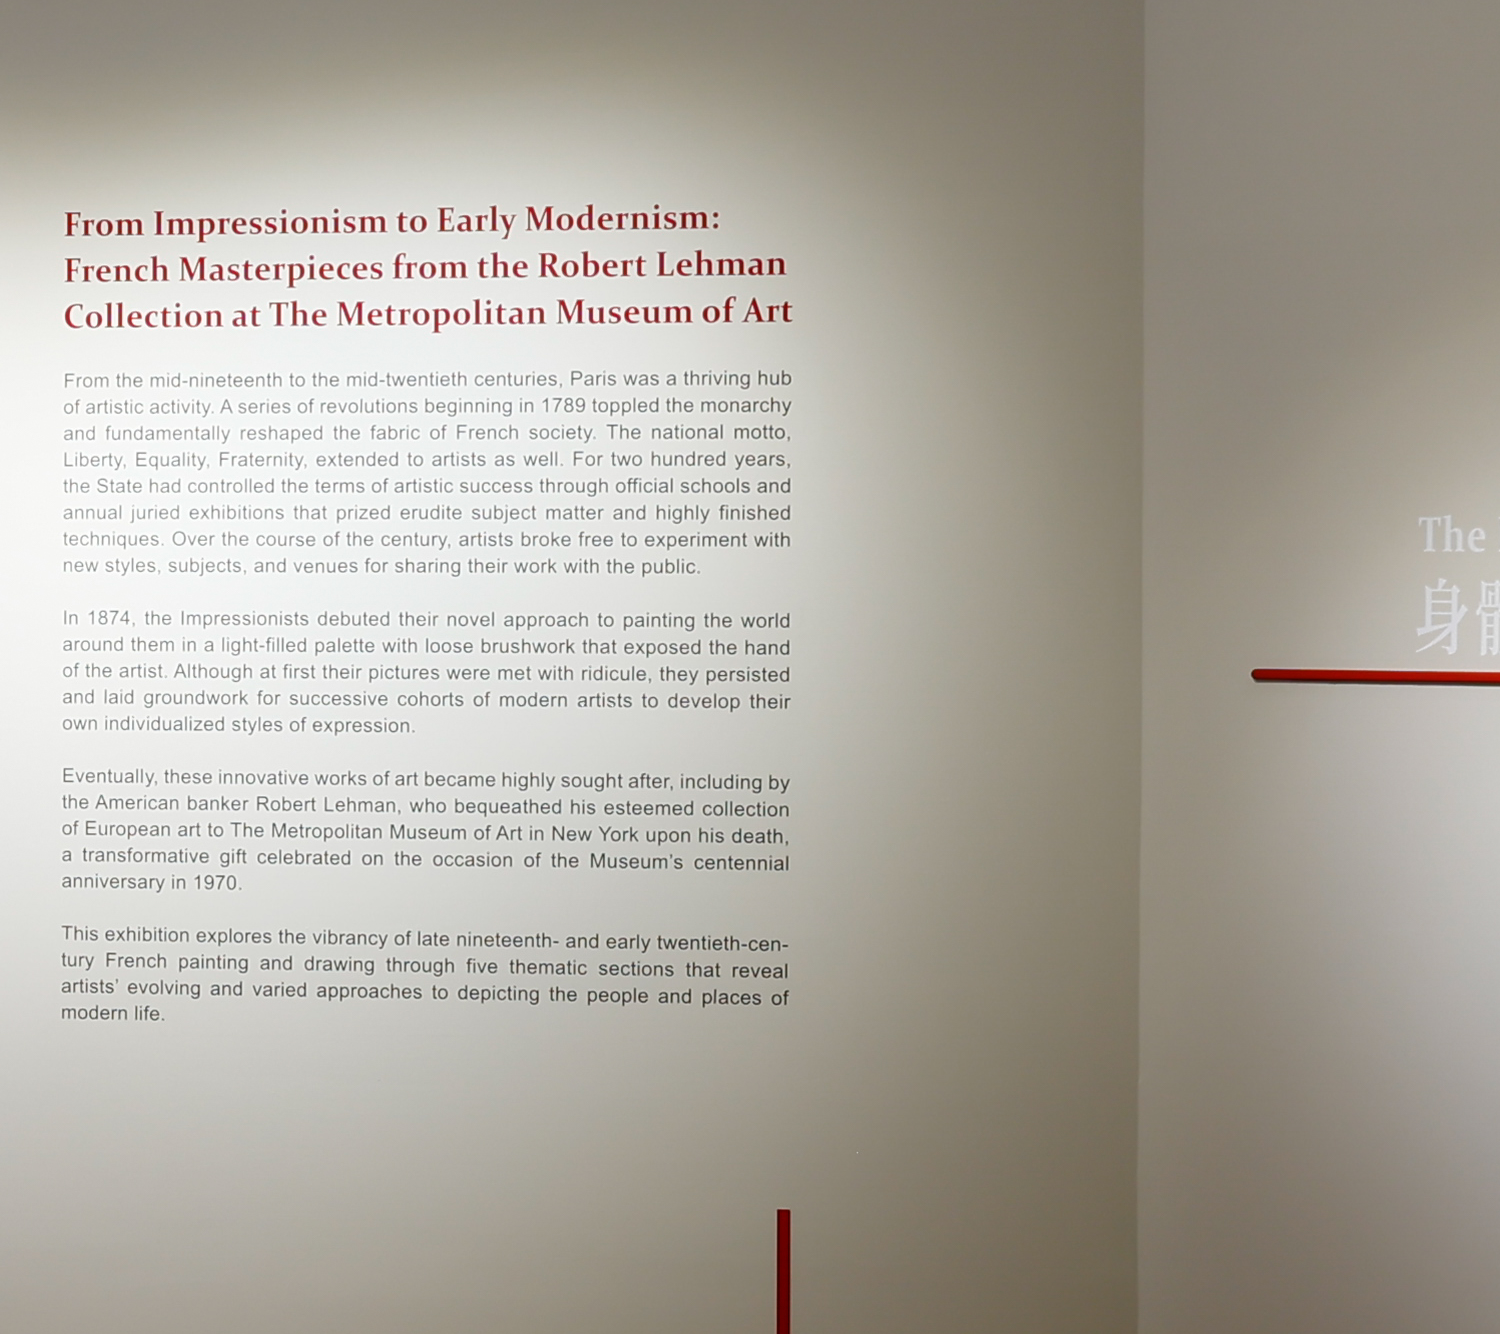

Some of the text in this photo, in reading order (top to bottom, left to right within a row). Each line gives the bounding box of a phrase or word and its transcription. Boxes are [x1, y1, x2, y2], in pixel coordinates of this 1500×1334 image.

[64, 203, 719, 244] From Impressionism to Early Modernism:
[64, 249, 787, 289] French Masterpieces from the Robert Lehman
[64, 295, 793, 334] Collection at The Metropolitan Museum of Art
[63, 369, 793, 391] From the mid-nineteenth to the mid-twentieth centuries, Paris was a thriving hub
[1418, 514, 1486, 553] The
[63, 609, 791, 633] In 1874, the Impressionists debuted their novel approach to painting the world
[61, 793, 790, 818] the American banker Robert Lehman, who bequeathed his esteemed collection
[60, 924, 790, 954] This exhibition explores the vibrancy of late nineteenth- and early twentieth-cen-
